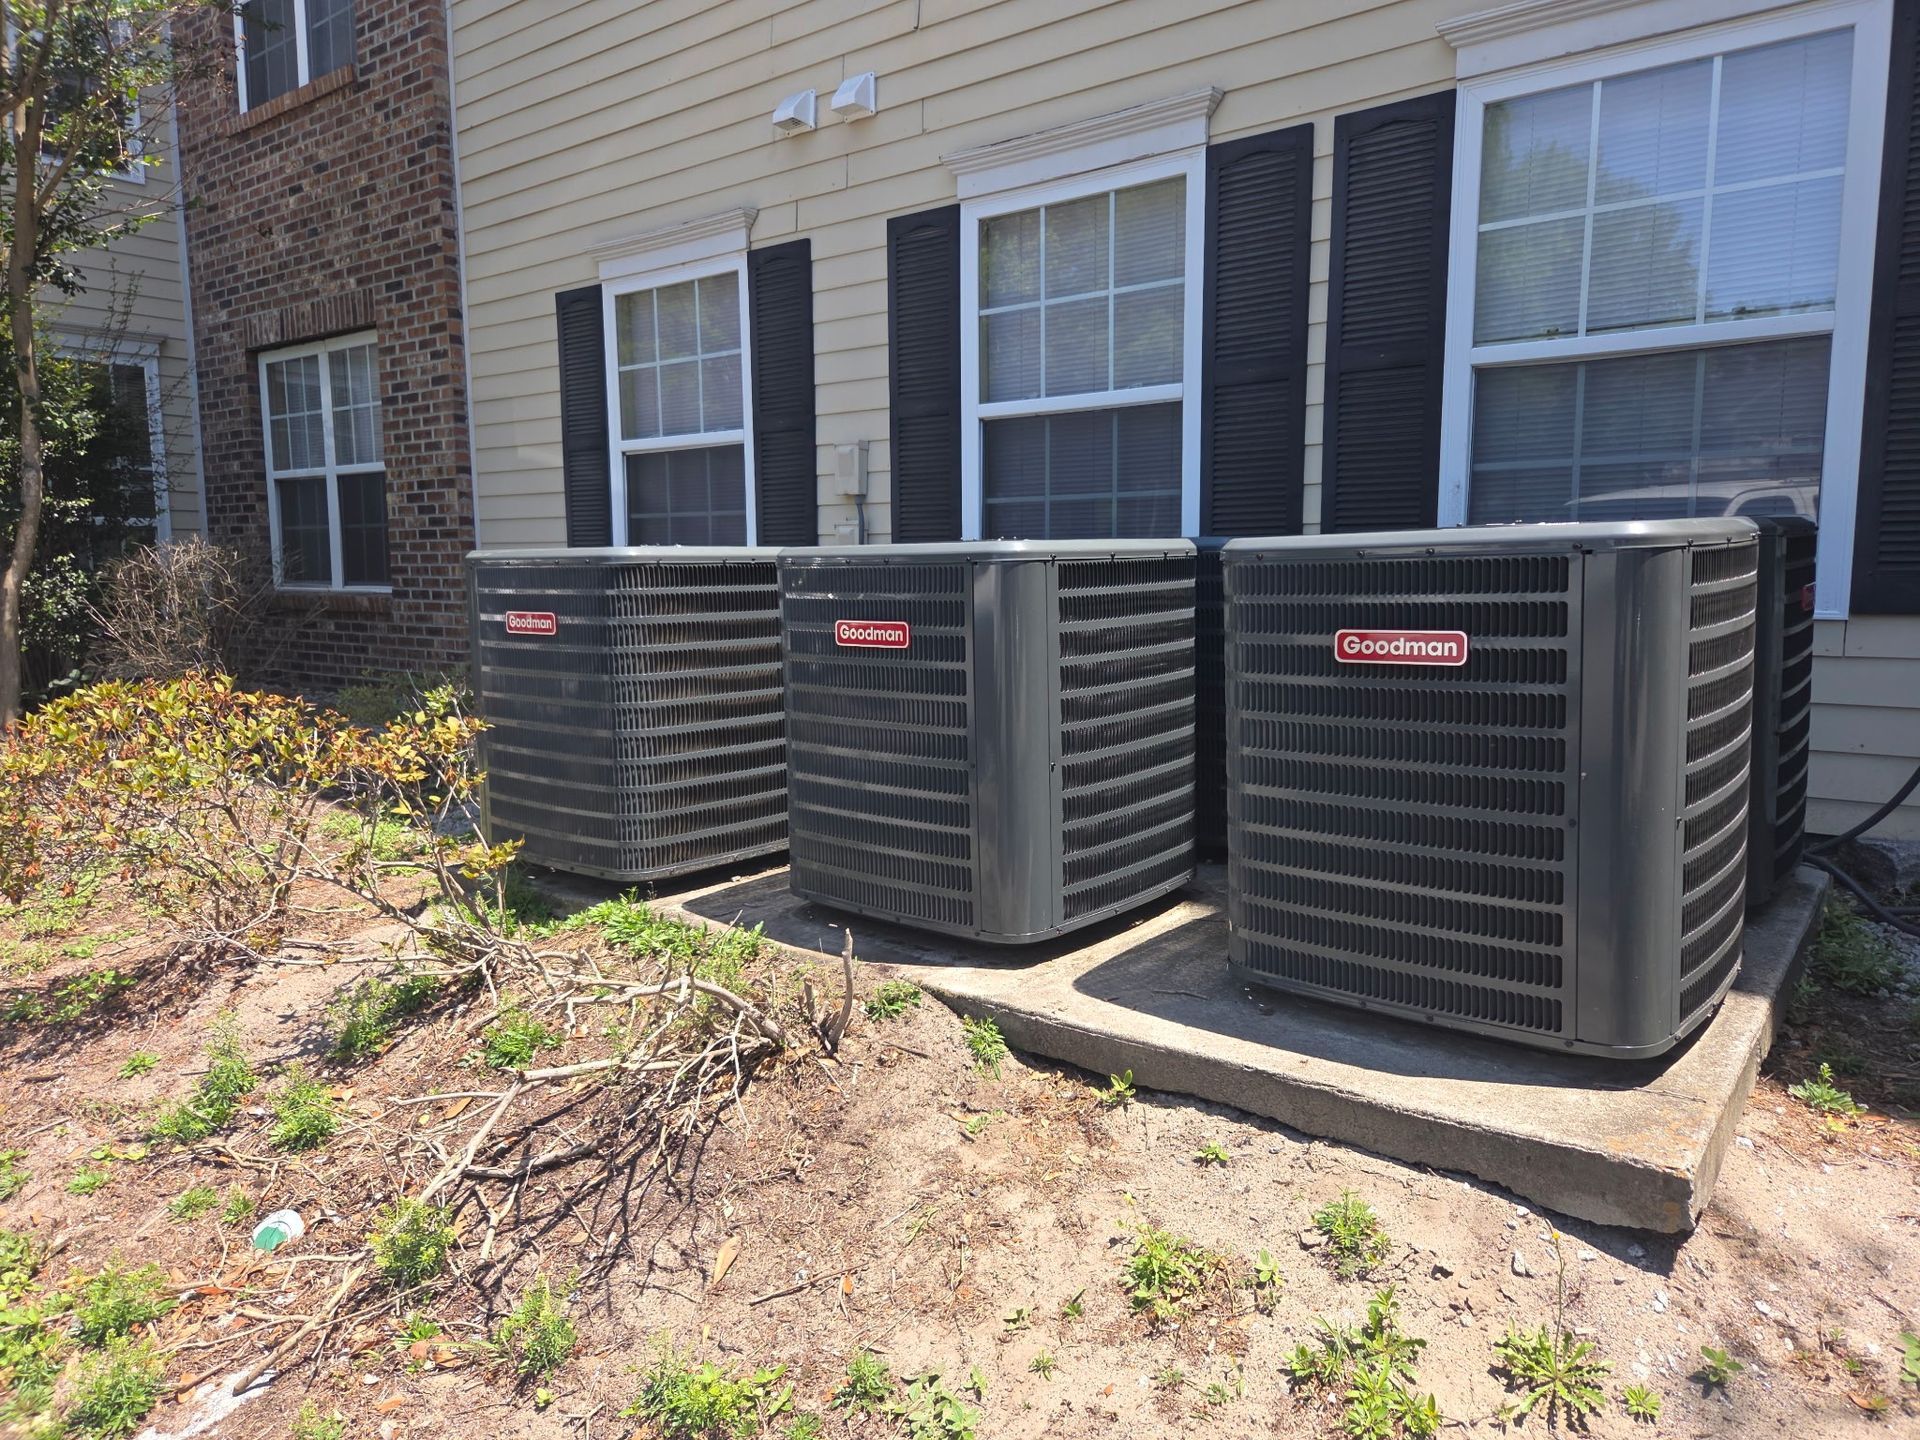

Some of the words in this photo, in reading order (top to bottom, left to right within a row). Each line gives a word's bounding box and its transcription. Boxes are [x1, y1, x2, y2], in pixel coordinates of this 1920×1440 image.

[509, 615, 552, 629] Goodman
[840, 624, 904, 642] Goodman
[1343, 635, 1458, 657] Goodman
